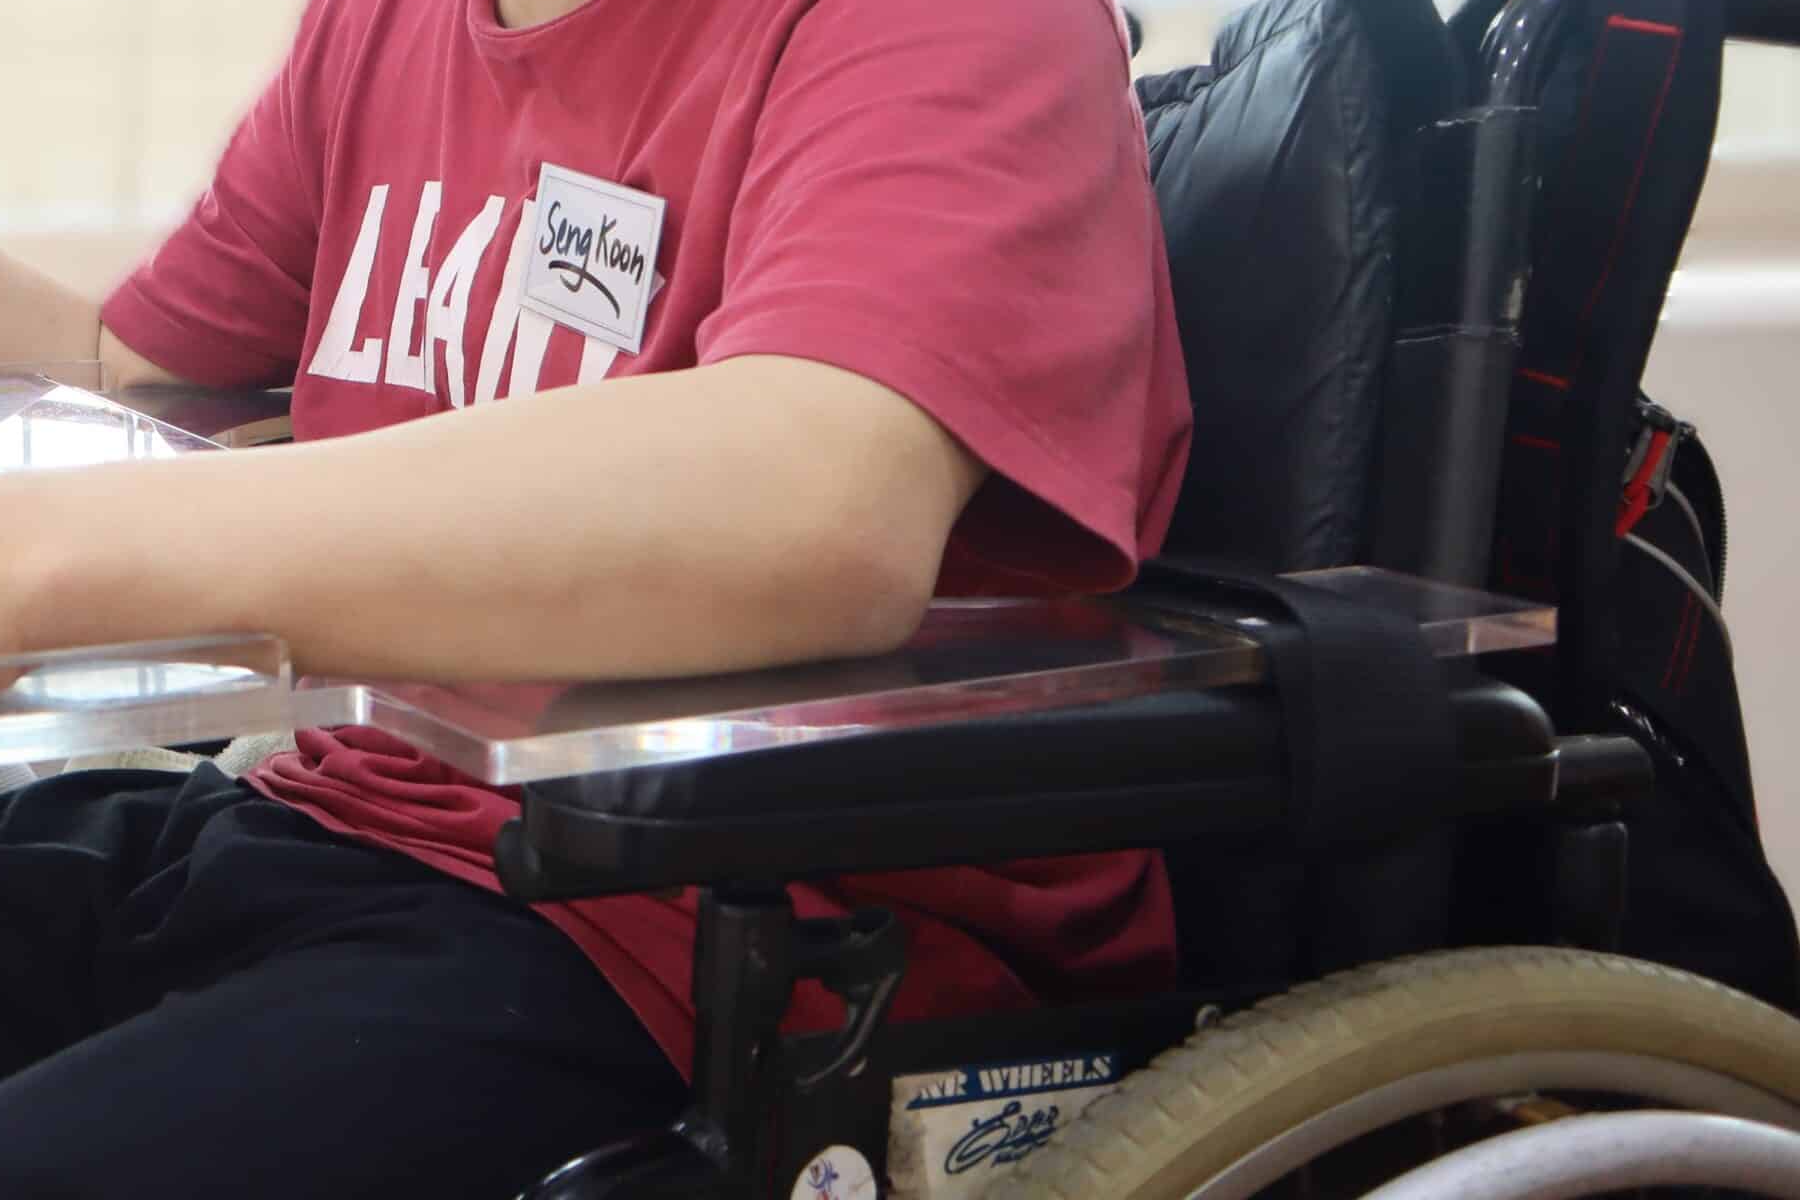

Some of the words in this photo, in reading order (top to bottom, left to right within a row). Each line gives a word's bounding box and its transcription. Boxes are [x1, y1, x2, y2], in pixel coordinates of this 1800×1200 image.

[539, 200, 593, 292] Seng
[596, 214, 644, 285] Koon
[979, 1056, 1112, 1093] WHEELS
